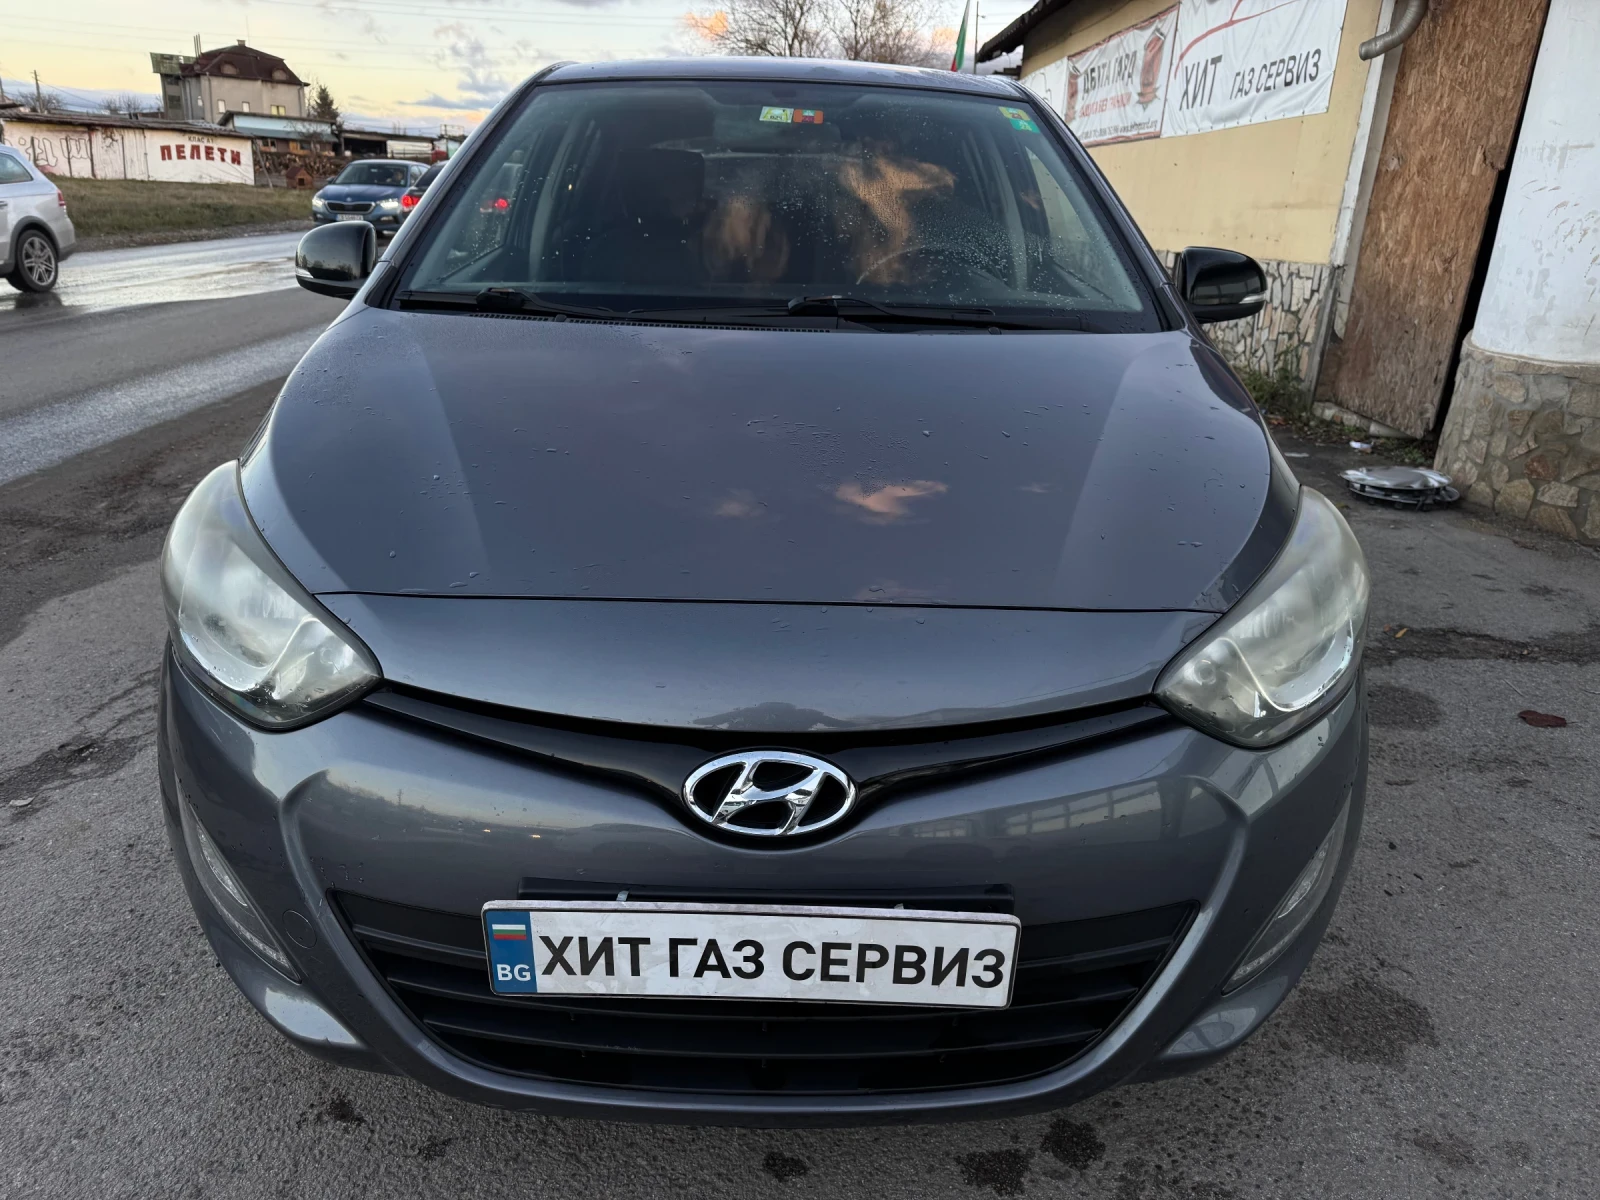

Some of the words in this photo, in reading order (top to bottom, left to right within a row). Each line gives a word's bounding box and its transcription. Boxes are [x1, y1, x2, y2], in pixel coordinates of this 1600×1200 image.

[1179, 55, 1223, 111] ХИТ
[1229, 67, 1255, 100] ГАЗ
[1255, 48, 1322, 94] СЕРВИЗ
[160, 144, 242, 166] ПЕЛЕТИ
[496, 963, 532, 982] BG
[539, 935, 651, 977] ХИТ
[668, 937, 765, 979] ГАЗ
[782, 940, 1006, 989] СЕРВИЗ
